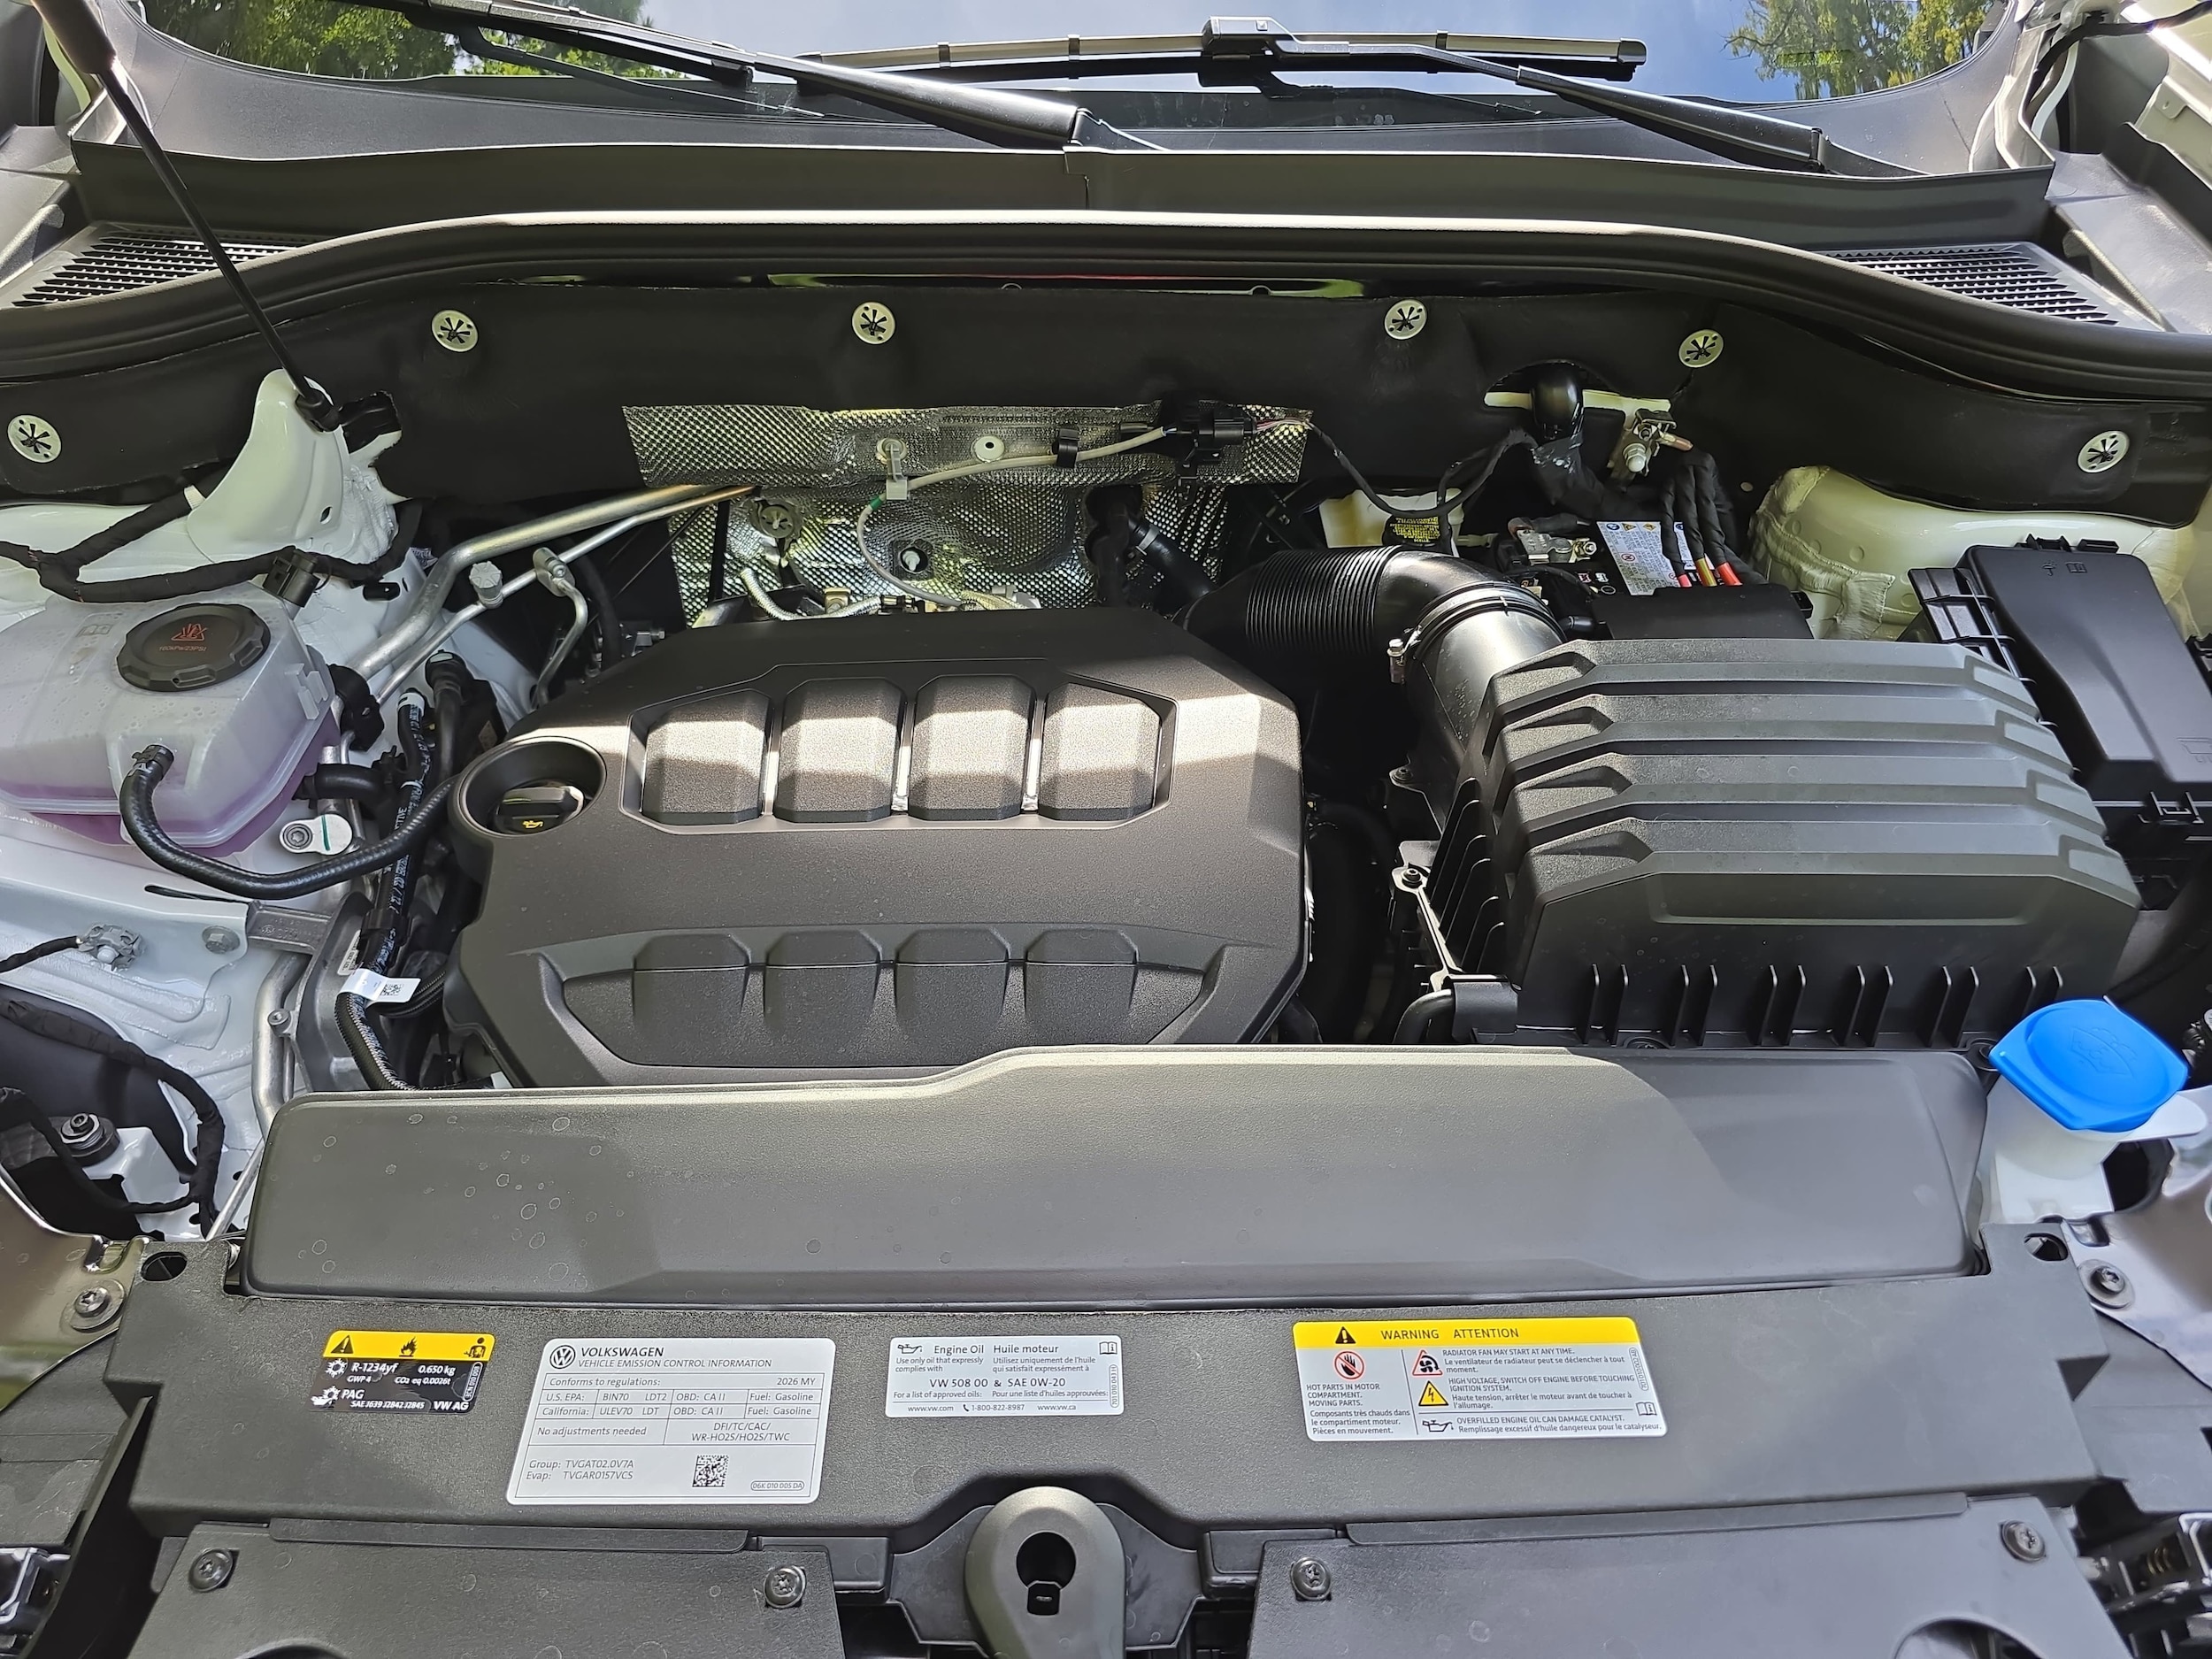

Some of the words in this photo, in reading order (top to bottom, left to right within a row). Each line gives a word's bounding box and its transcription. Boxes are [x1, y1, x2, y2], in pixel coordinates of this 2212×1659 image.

[1380, 1329, 1439, 1340] WARNING
[1453, 1328, 1519, 1339] ATTENTION
[580, 1347, 664, 1357] VOLKSWAGEN
[934, 1345, 968, 1356] Engine
[970, 1345, 984, 1354] Oil
[994, 1345, 1019, 1354] Huile
[1022, 1345, 1059, 1354] moteur
[579, 1359, 615, 1368] VEHICLE
[618, 1359, 661, 1368] EMISSION
[664, 1359, 706, 1368] CONTROL
[708, 1359, 772, 1368] INFORMATION
[352, 1363, 398, 1376] R-1234yf
[418, 1365, 443, 1374] 0.650
[444, 1365, 456, 1376] kg
[1035, 1364, 1083, 1373] expressément
[607, 1378, 661, 1387] regulations:
[777, 1377, 798, 1386] 2026
[800, 1377, 816, 1386] MY
[929, 1379, 949, 1387] VW
[952, 1379, 972, 1387] 508
[973, 1379, 988, 1387] 00
[994, 1379, 1002, 1387] &
[1007, 1379, 1027, 1387] SAE
[1030, 1379, 1066, 1387] 0W-20
[342, 1389, 365, 1400] PAG
[546, 1393, 563, 1402] U.S.
[565, 1393, 585, 1402] EPA:
[603, 1393, 630, 1402] BIN70
[646, 1393, 667, 1402] LDT2
[676, 1393, 700, 1402] OBD:
[703, 1393, 717, 1402] CA
[749, 1393, 771, 1402] Fuel:
[775, 1393, 814, 1402] Gasoline
[933, 1391, 966, 1400] approved
[1066, 1389, 1109, 1398] approuvées:
[434, 1402, 455, 1410] VW
[455, 1402, 469, 1410] AG
[972, 1403, 1025, 1412] 1-800-822-8987
[542, 1407, 589, 1416] California:
[600, 1407, 634, 1416] ULEV70
[642, 1407, 660, 1416] LDT
[674, 1407, 697, 1416] OBD:
[701, 1407, 715, 1416] CA
[748, 1407, 769, 1416] Fuel:
[773, 1407, 812, 1416] Gasoline
[538, 1426, 550, 1435] No
[552, 1426, 611, 1437] adjustments
[612, 1426, 647, 1435] needed
[1559, 1425, 1596, 1433] dangereux
[1623, 1423, 1662, 1432] catalyseur.
[529, 1460, 561, 1470] Group:
[526, 1471, 552, 1481] Evap:
